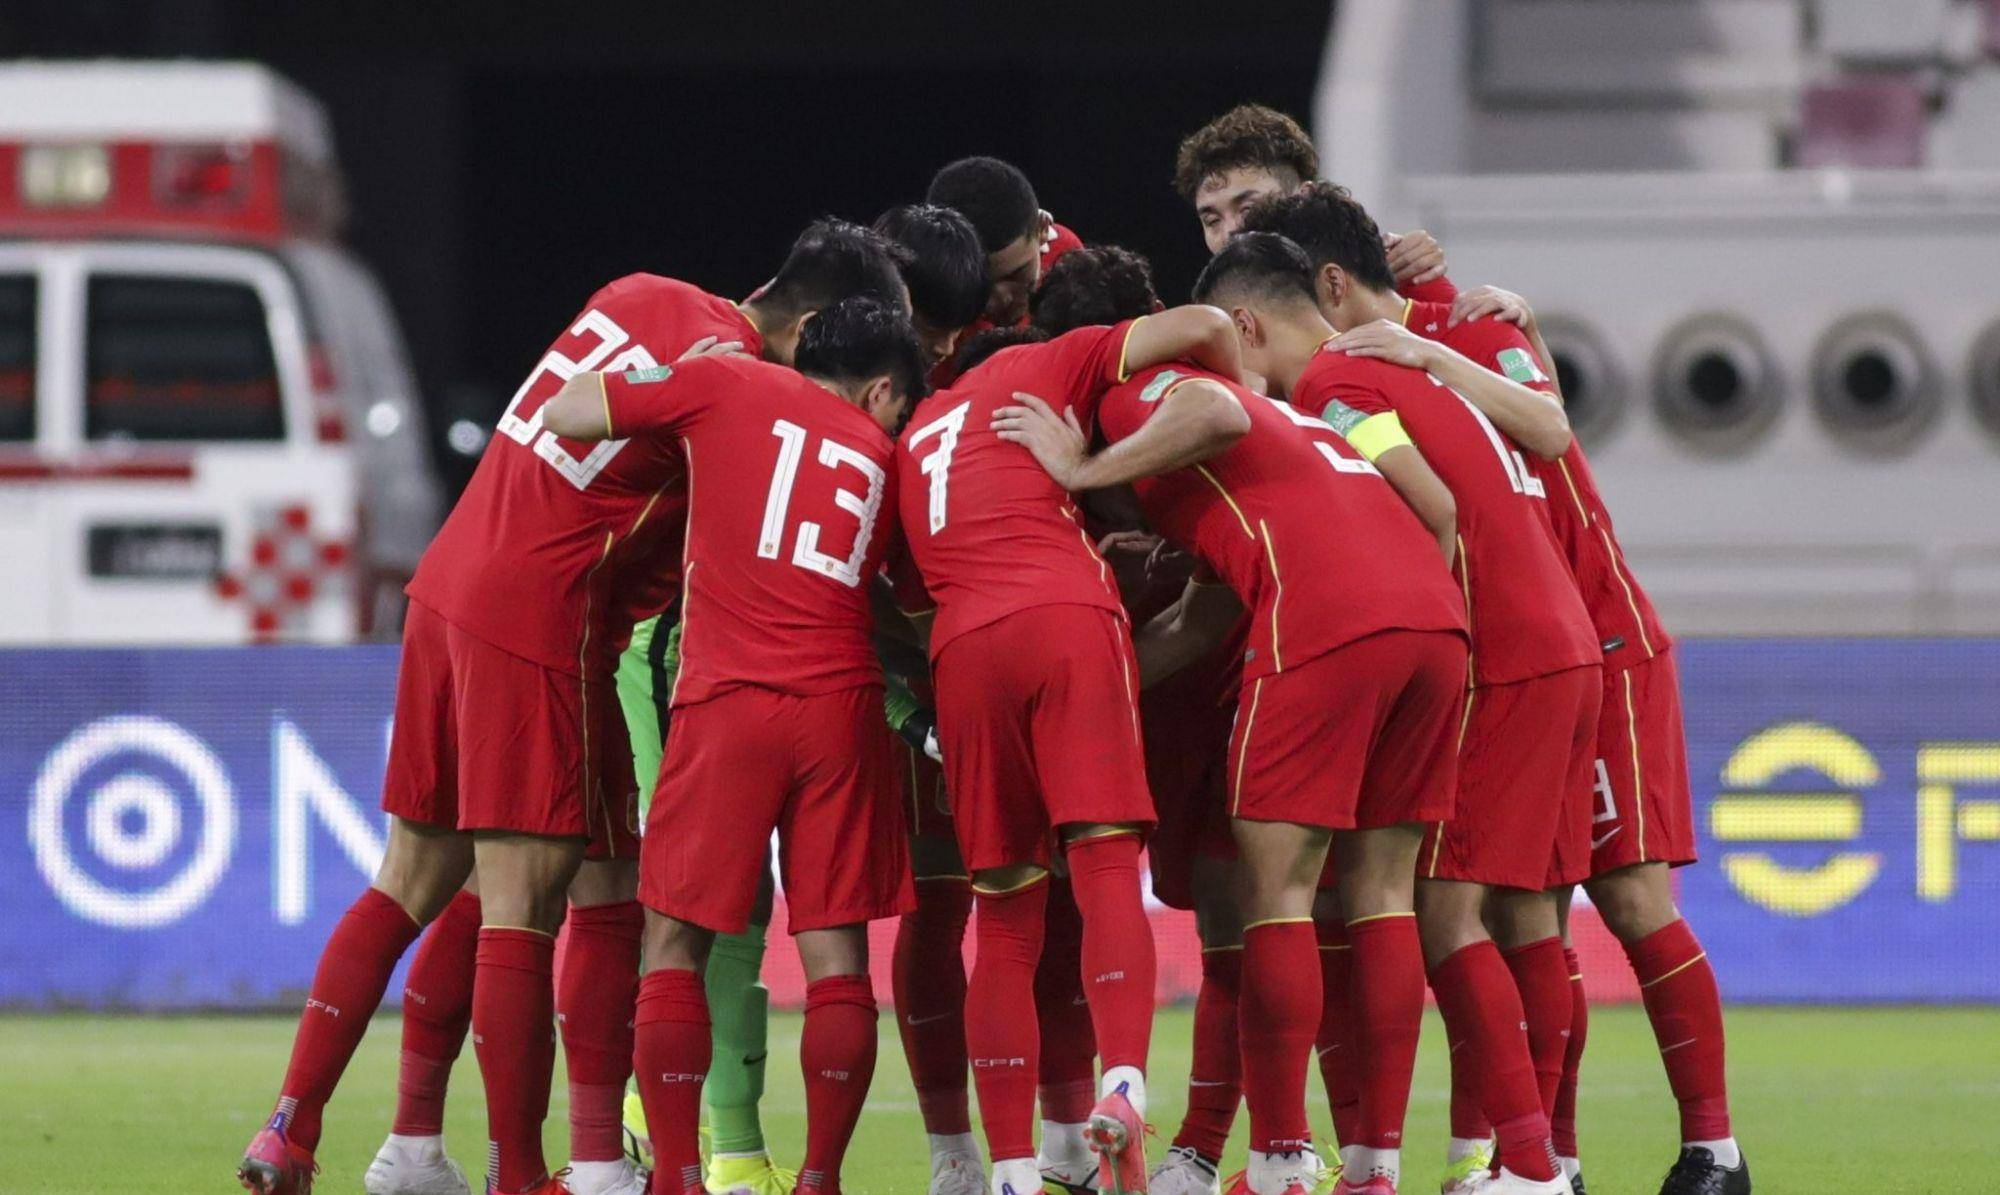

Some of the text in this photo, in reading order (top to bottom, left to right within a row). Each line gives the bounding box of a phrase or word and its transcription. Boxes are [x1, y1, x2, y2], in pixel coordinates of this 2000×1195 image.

[756, 418, 886, 588] 13
[908, 400, 972, 536] 7
[975, 1057, 1025, 1067] CFA
